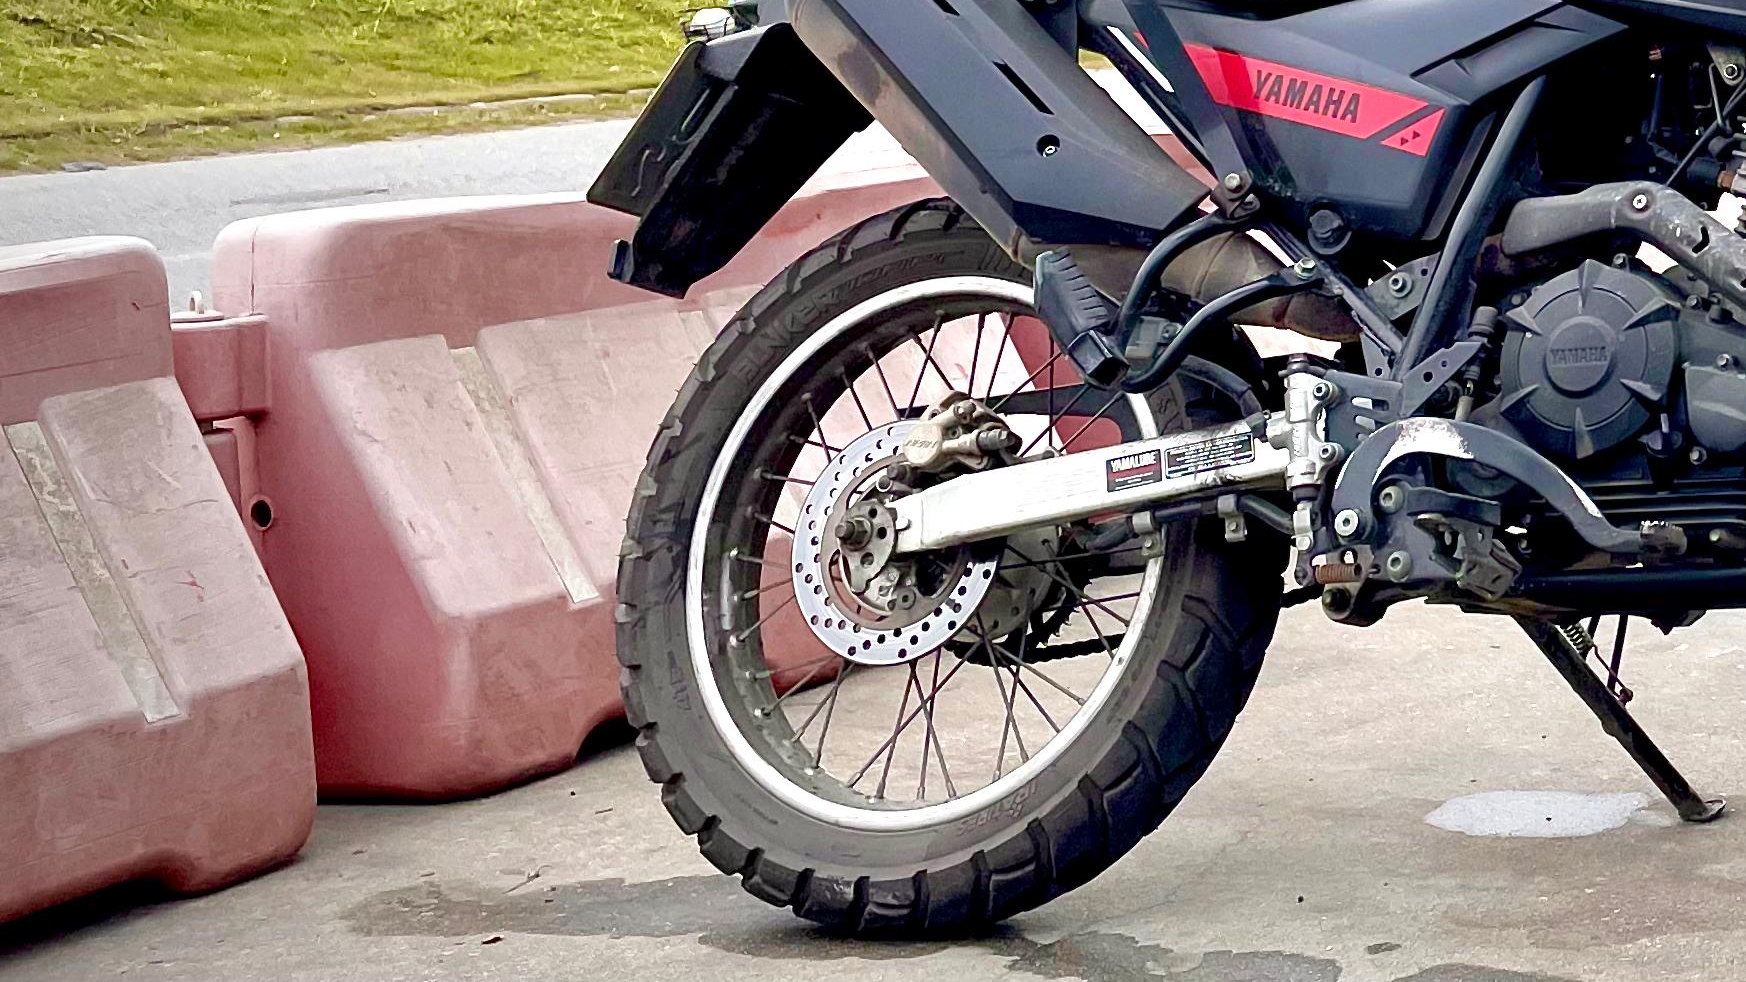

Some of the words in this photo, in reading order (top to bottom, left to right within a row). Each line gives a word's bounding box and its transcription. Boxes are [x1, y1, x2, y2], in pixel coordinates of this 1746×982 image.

[1253, 69, 1361, 124] YAMAHA
[1550, 346, 1608, 365] YAMAHA
[1110, 451, 1157, 473] YAMALUBE
